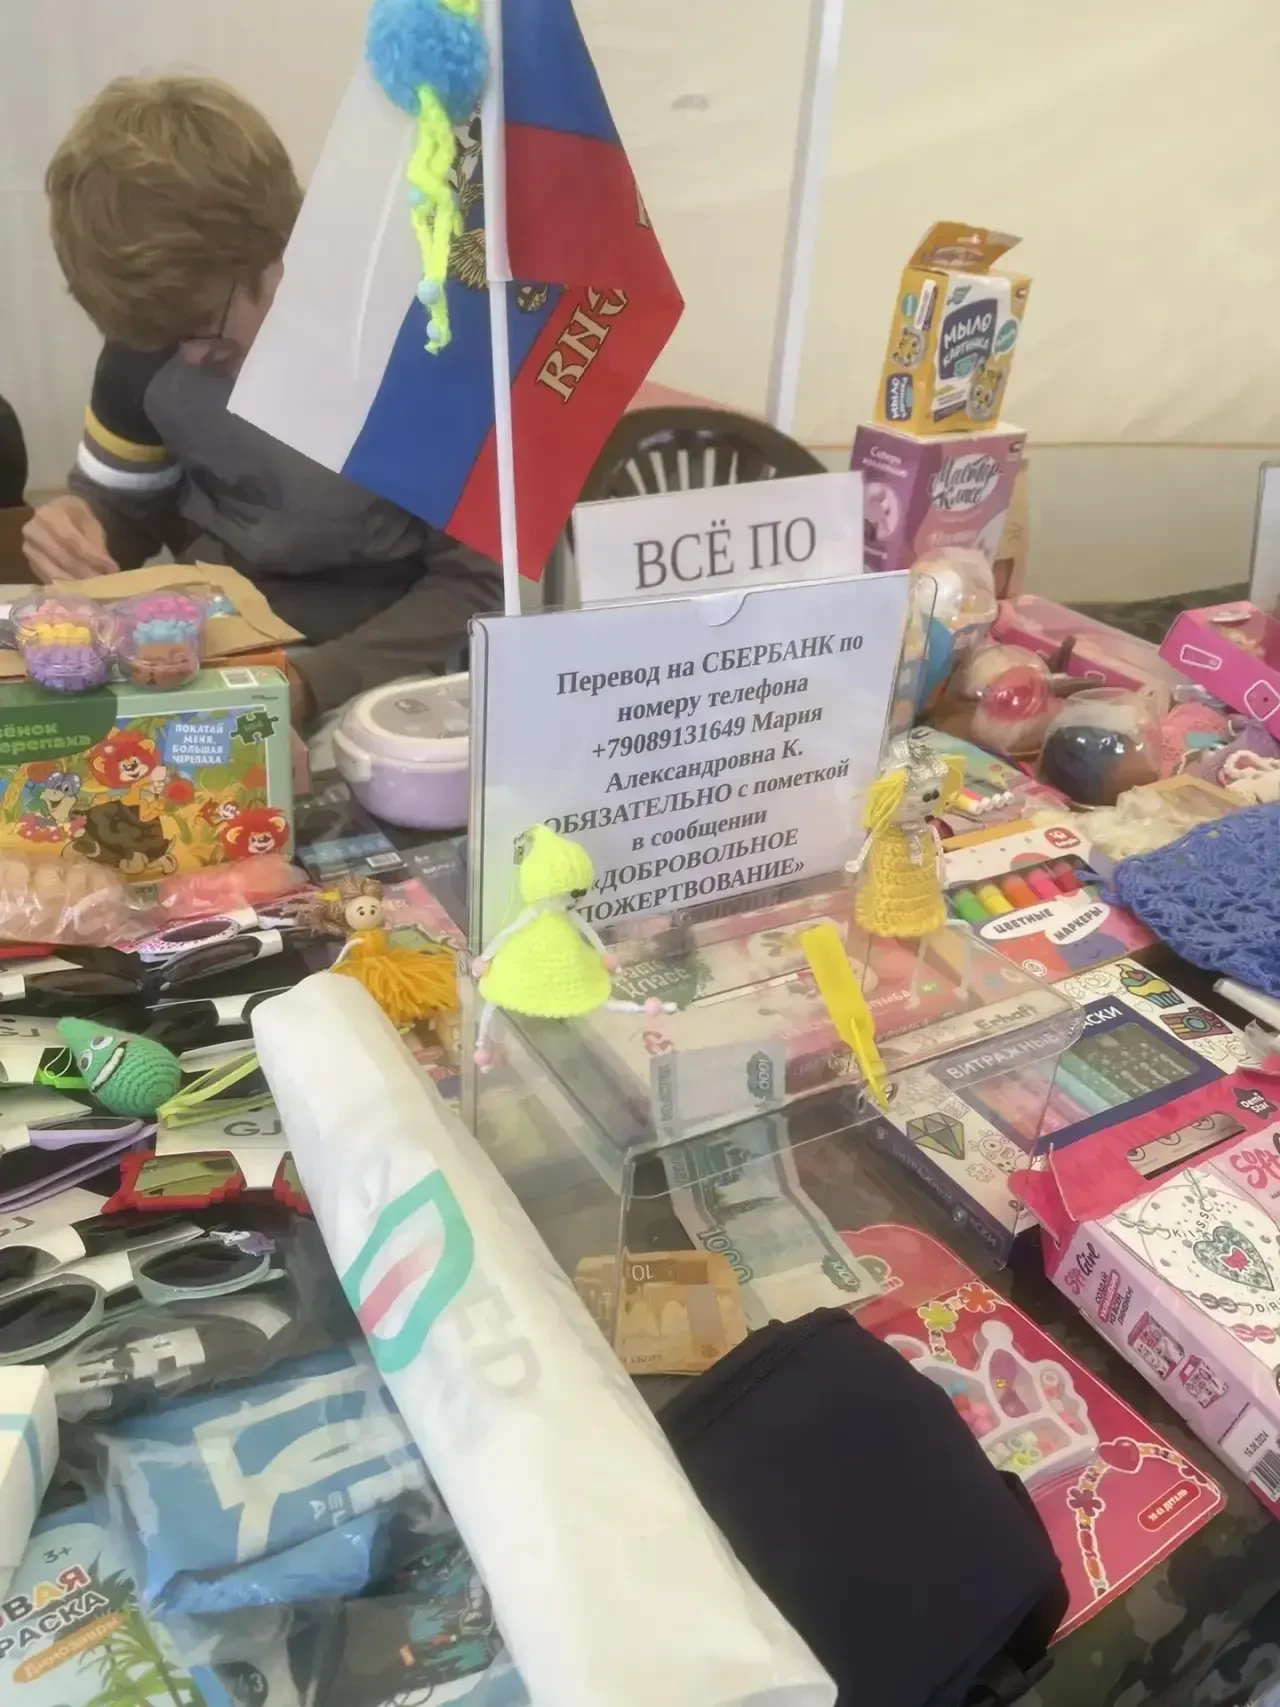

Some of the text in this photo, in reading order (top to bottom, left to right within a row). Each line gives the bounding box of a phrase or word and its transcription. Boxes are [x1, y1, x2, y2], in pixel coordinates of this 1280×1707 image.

[943, 312, 993, 350] МЫЛО
[634, 516, 817, 590] ВСЁ ПО
[557, 632, 864, 697] Перевод на СБЕРБАНК по
[617, 675, 809, 723] номеру телефона
[174, 723, 224, 734] ПОКАТАЙ
[591, 706, 823, 761] +79089131649 Мария
[172, 744, 223, 754] БОЛЬШАЯ
[604, 739, 804, 794] Александровна К.
[543, 758, 850, 835] ОБЯЗАТЕЛЬНО с пометкой
[632, 810, 767, 851] в сообщении
[591, 828, 799, 895] «ДОБРОВОЛЬНОЕ
[578, 857, 805, 923] ПОЖЕРТВОВАНИЕ»
[993, 908, 1054, 934] ЦВЕТНЫЕ
[1053, 906, 1103, 942] МАРКЕРЫ
[946, 1026, 1062, 1080] ВИТРАЖНЫЕ
[1240, 1092, 1265, 1108] Demi
[1250, 1102, 1270, 1113] Star
[223, 1119, 282, 1136] GJ
[631, 1263, 655, 1281] 10
[1076, 1242, 1100, 1276] Girl
[43, 1545, 72, 1564] 3+
